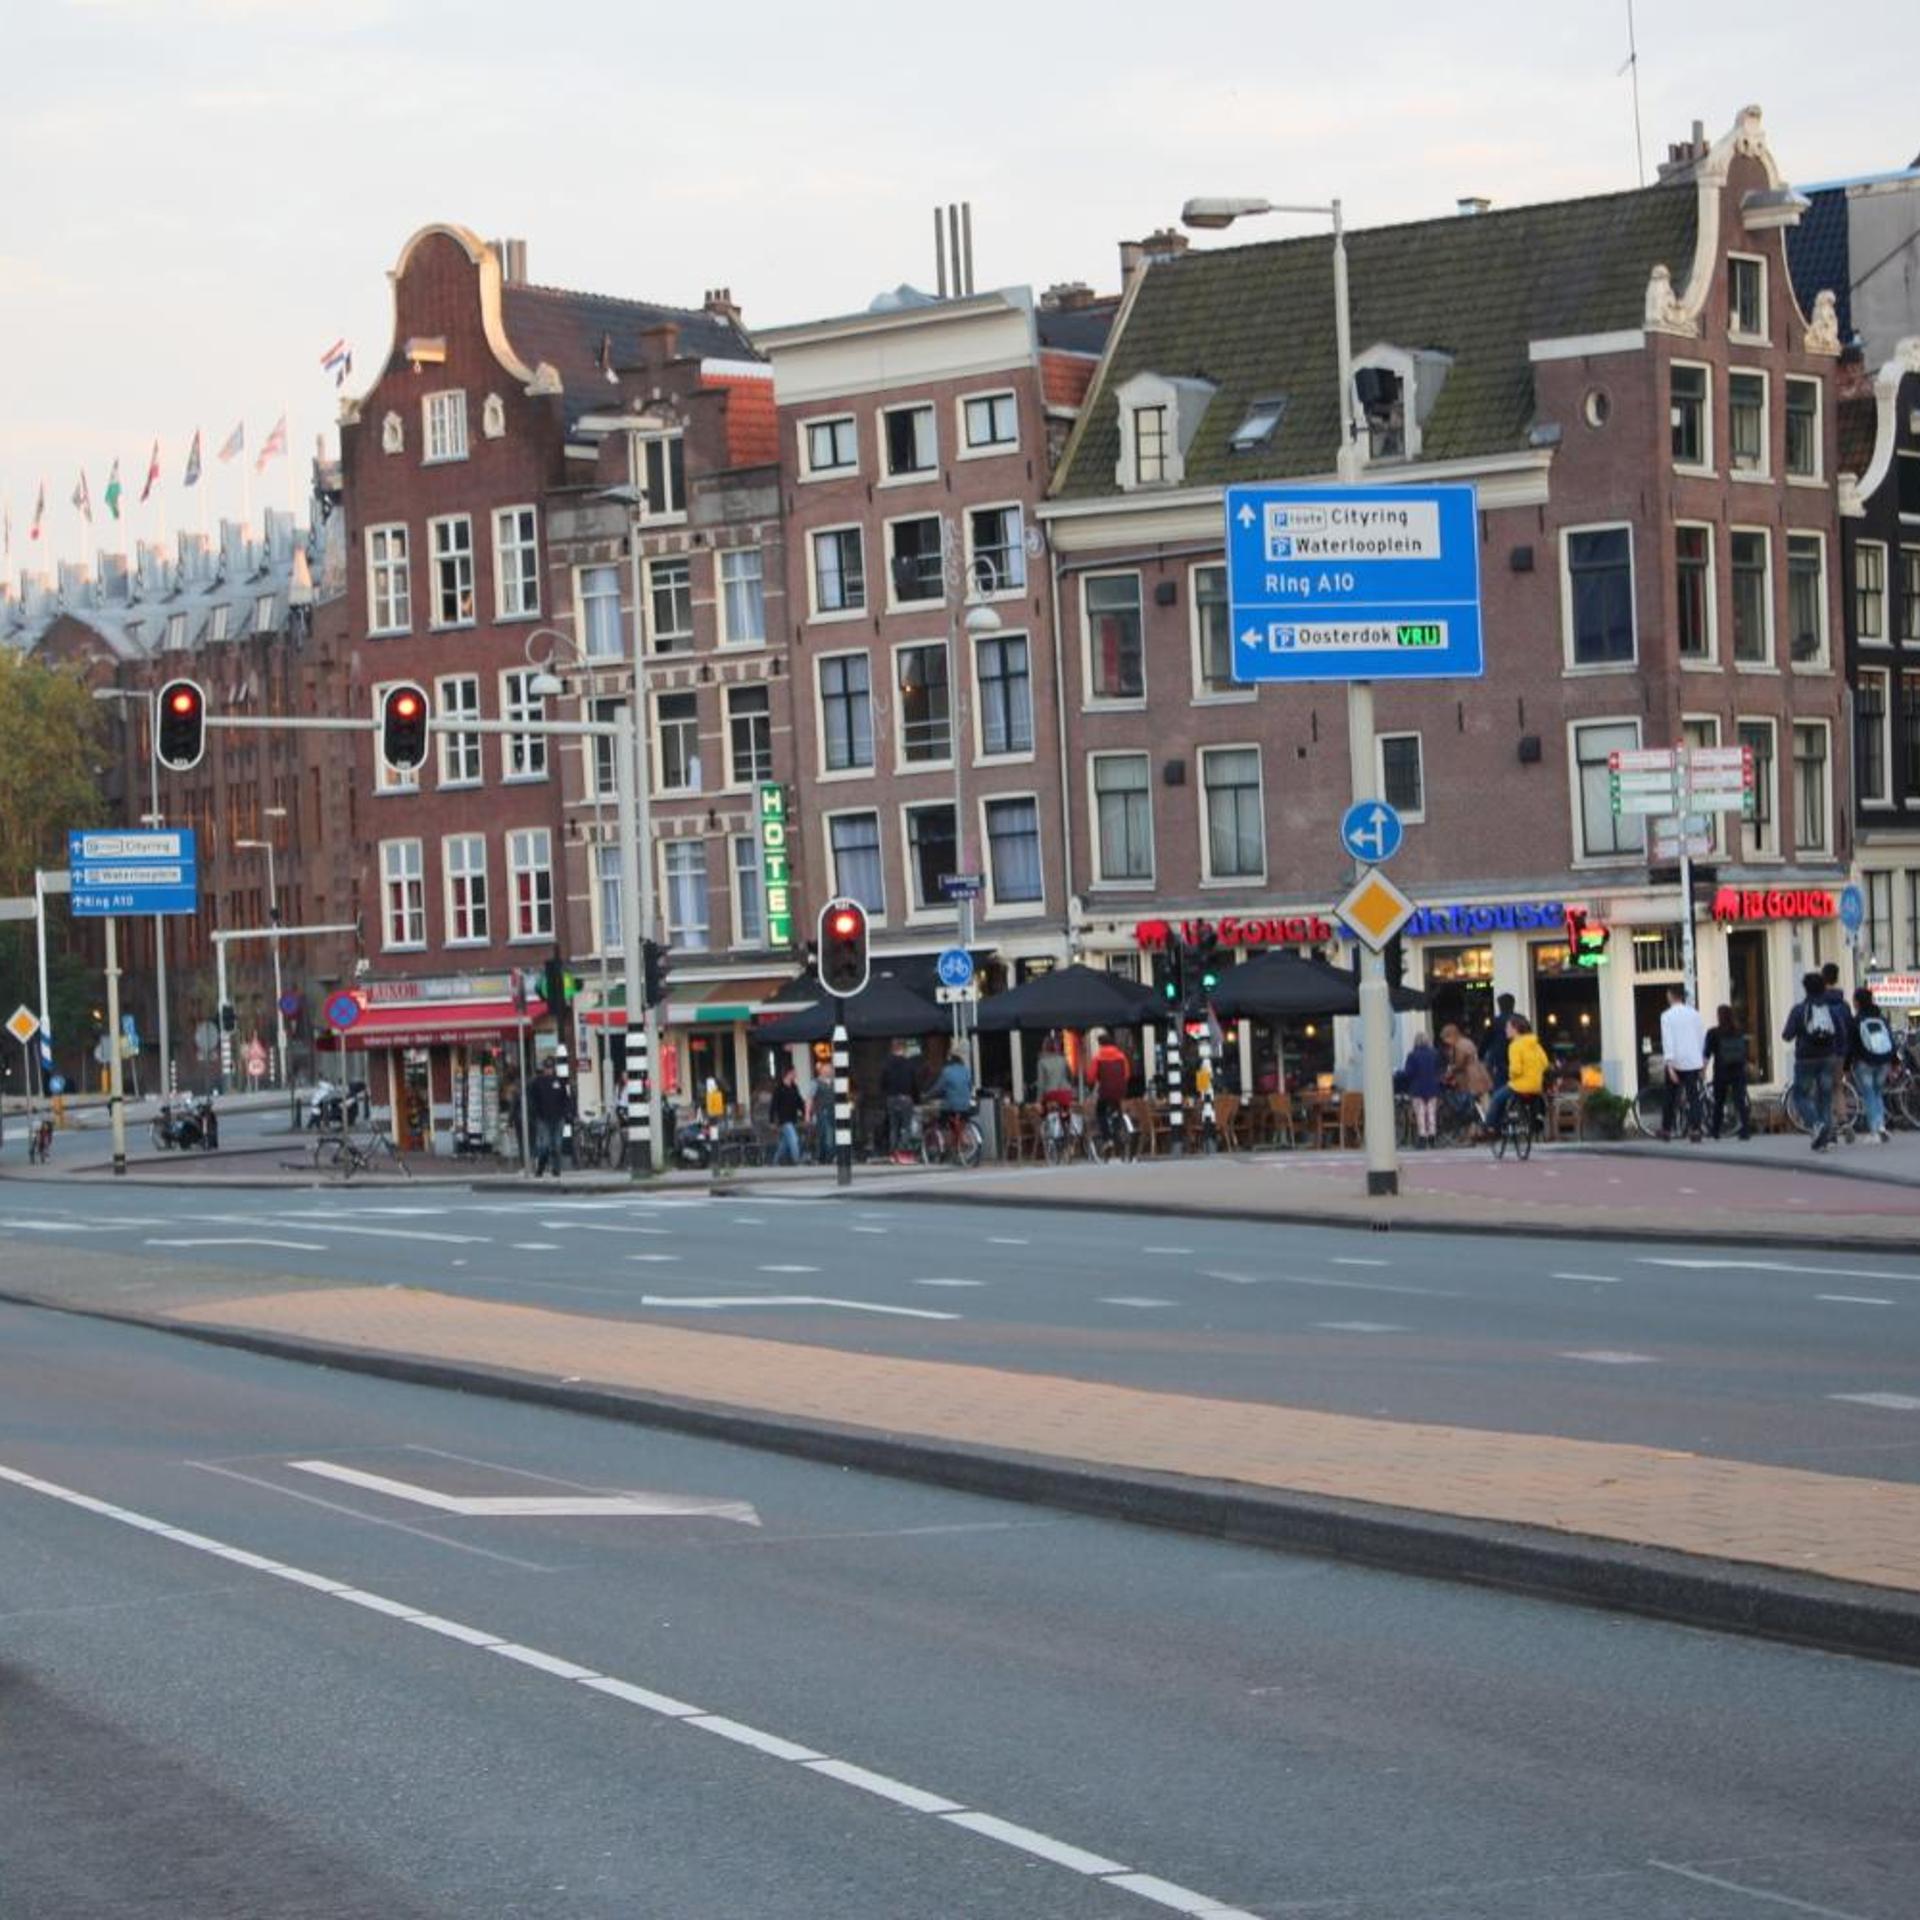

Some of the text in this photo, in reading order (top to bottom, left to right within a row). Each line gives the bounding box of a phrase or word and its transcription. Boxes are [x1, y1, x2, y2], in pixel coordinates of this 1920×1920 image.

[1331, 509, 1408, 527] Cityring
[1296, 536, 1422, 553] Waterlooplein
[1265, 573, 1355, 597] Ring A10
[1300, 628, 1391, 644] Oosterdok
[762, 790, 789, 944] HOTEL
